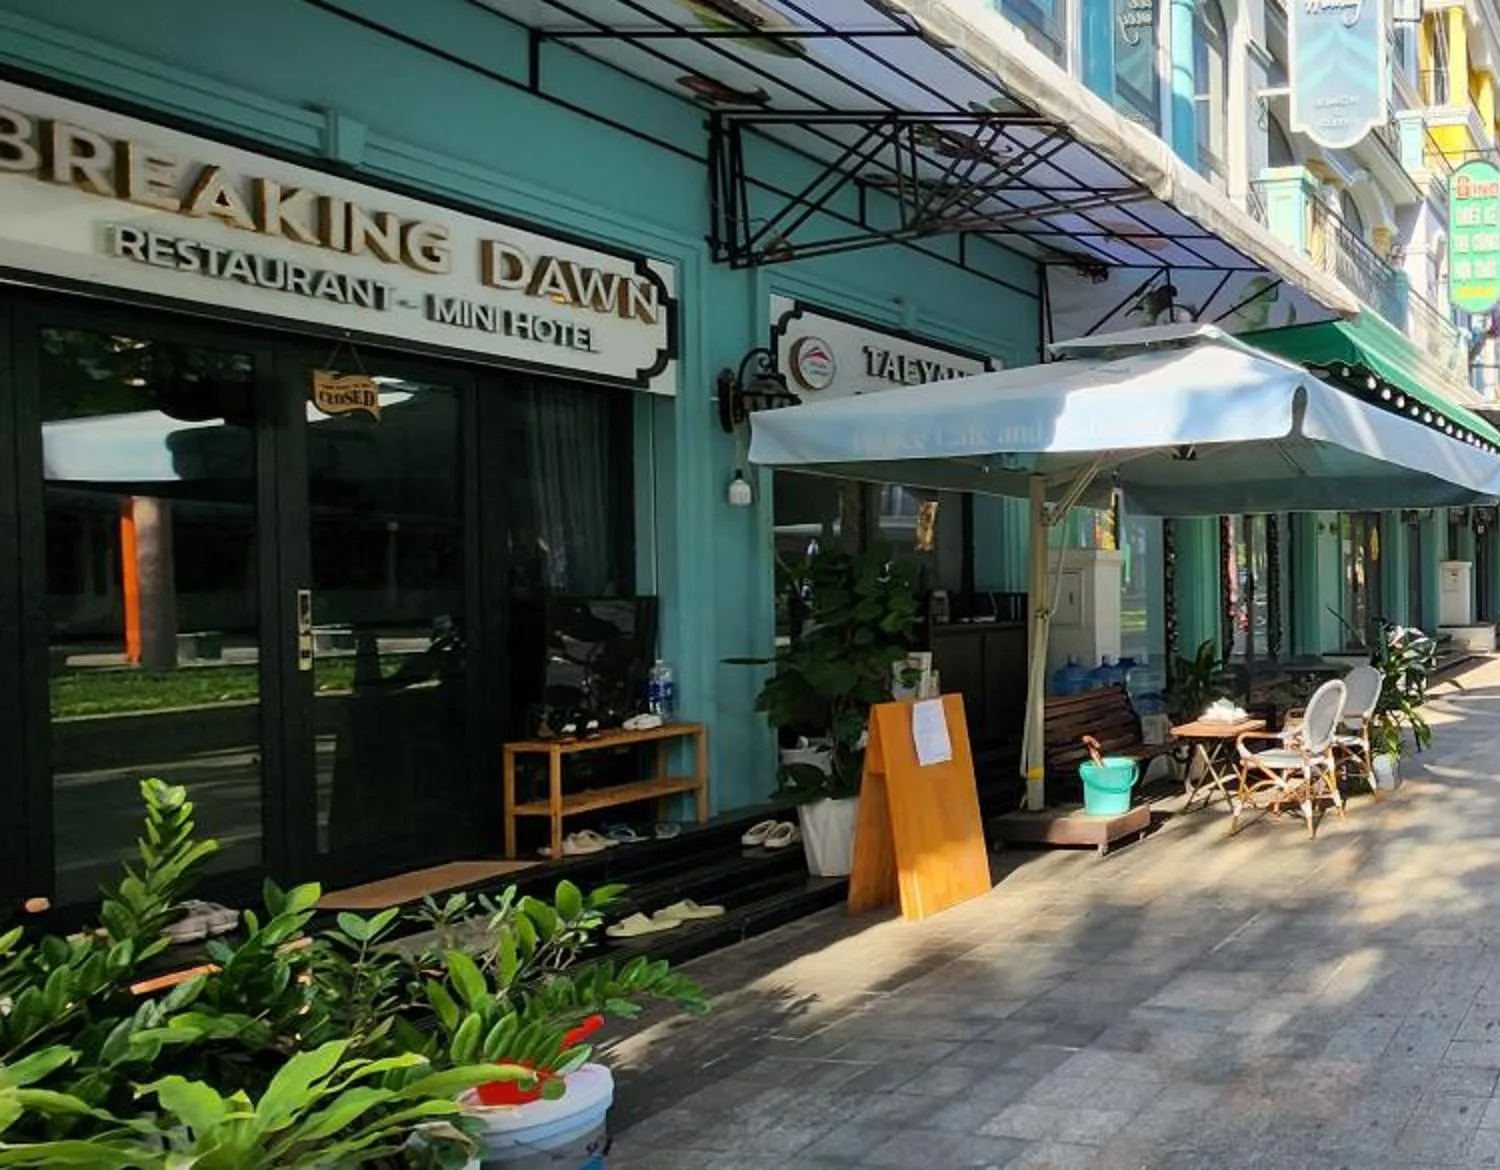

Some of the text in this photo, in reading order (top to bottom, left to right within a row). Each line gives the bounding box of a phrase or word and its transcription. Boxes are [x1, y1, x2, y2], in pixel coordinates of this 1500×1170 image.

[0, 105, 659, 324] BREAKING DAWN
[113, 222, 396, 312] RESTAURANT
[427, 293, 504, 335] MINI
[505, 309, 598, 354] HOTEL
[319, 389, 375, 407] CLOSED
